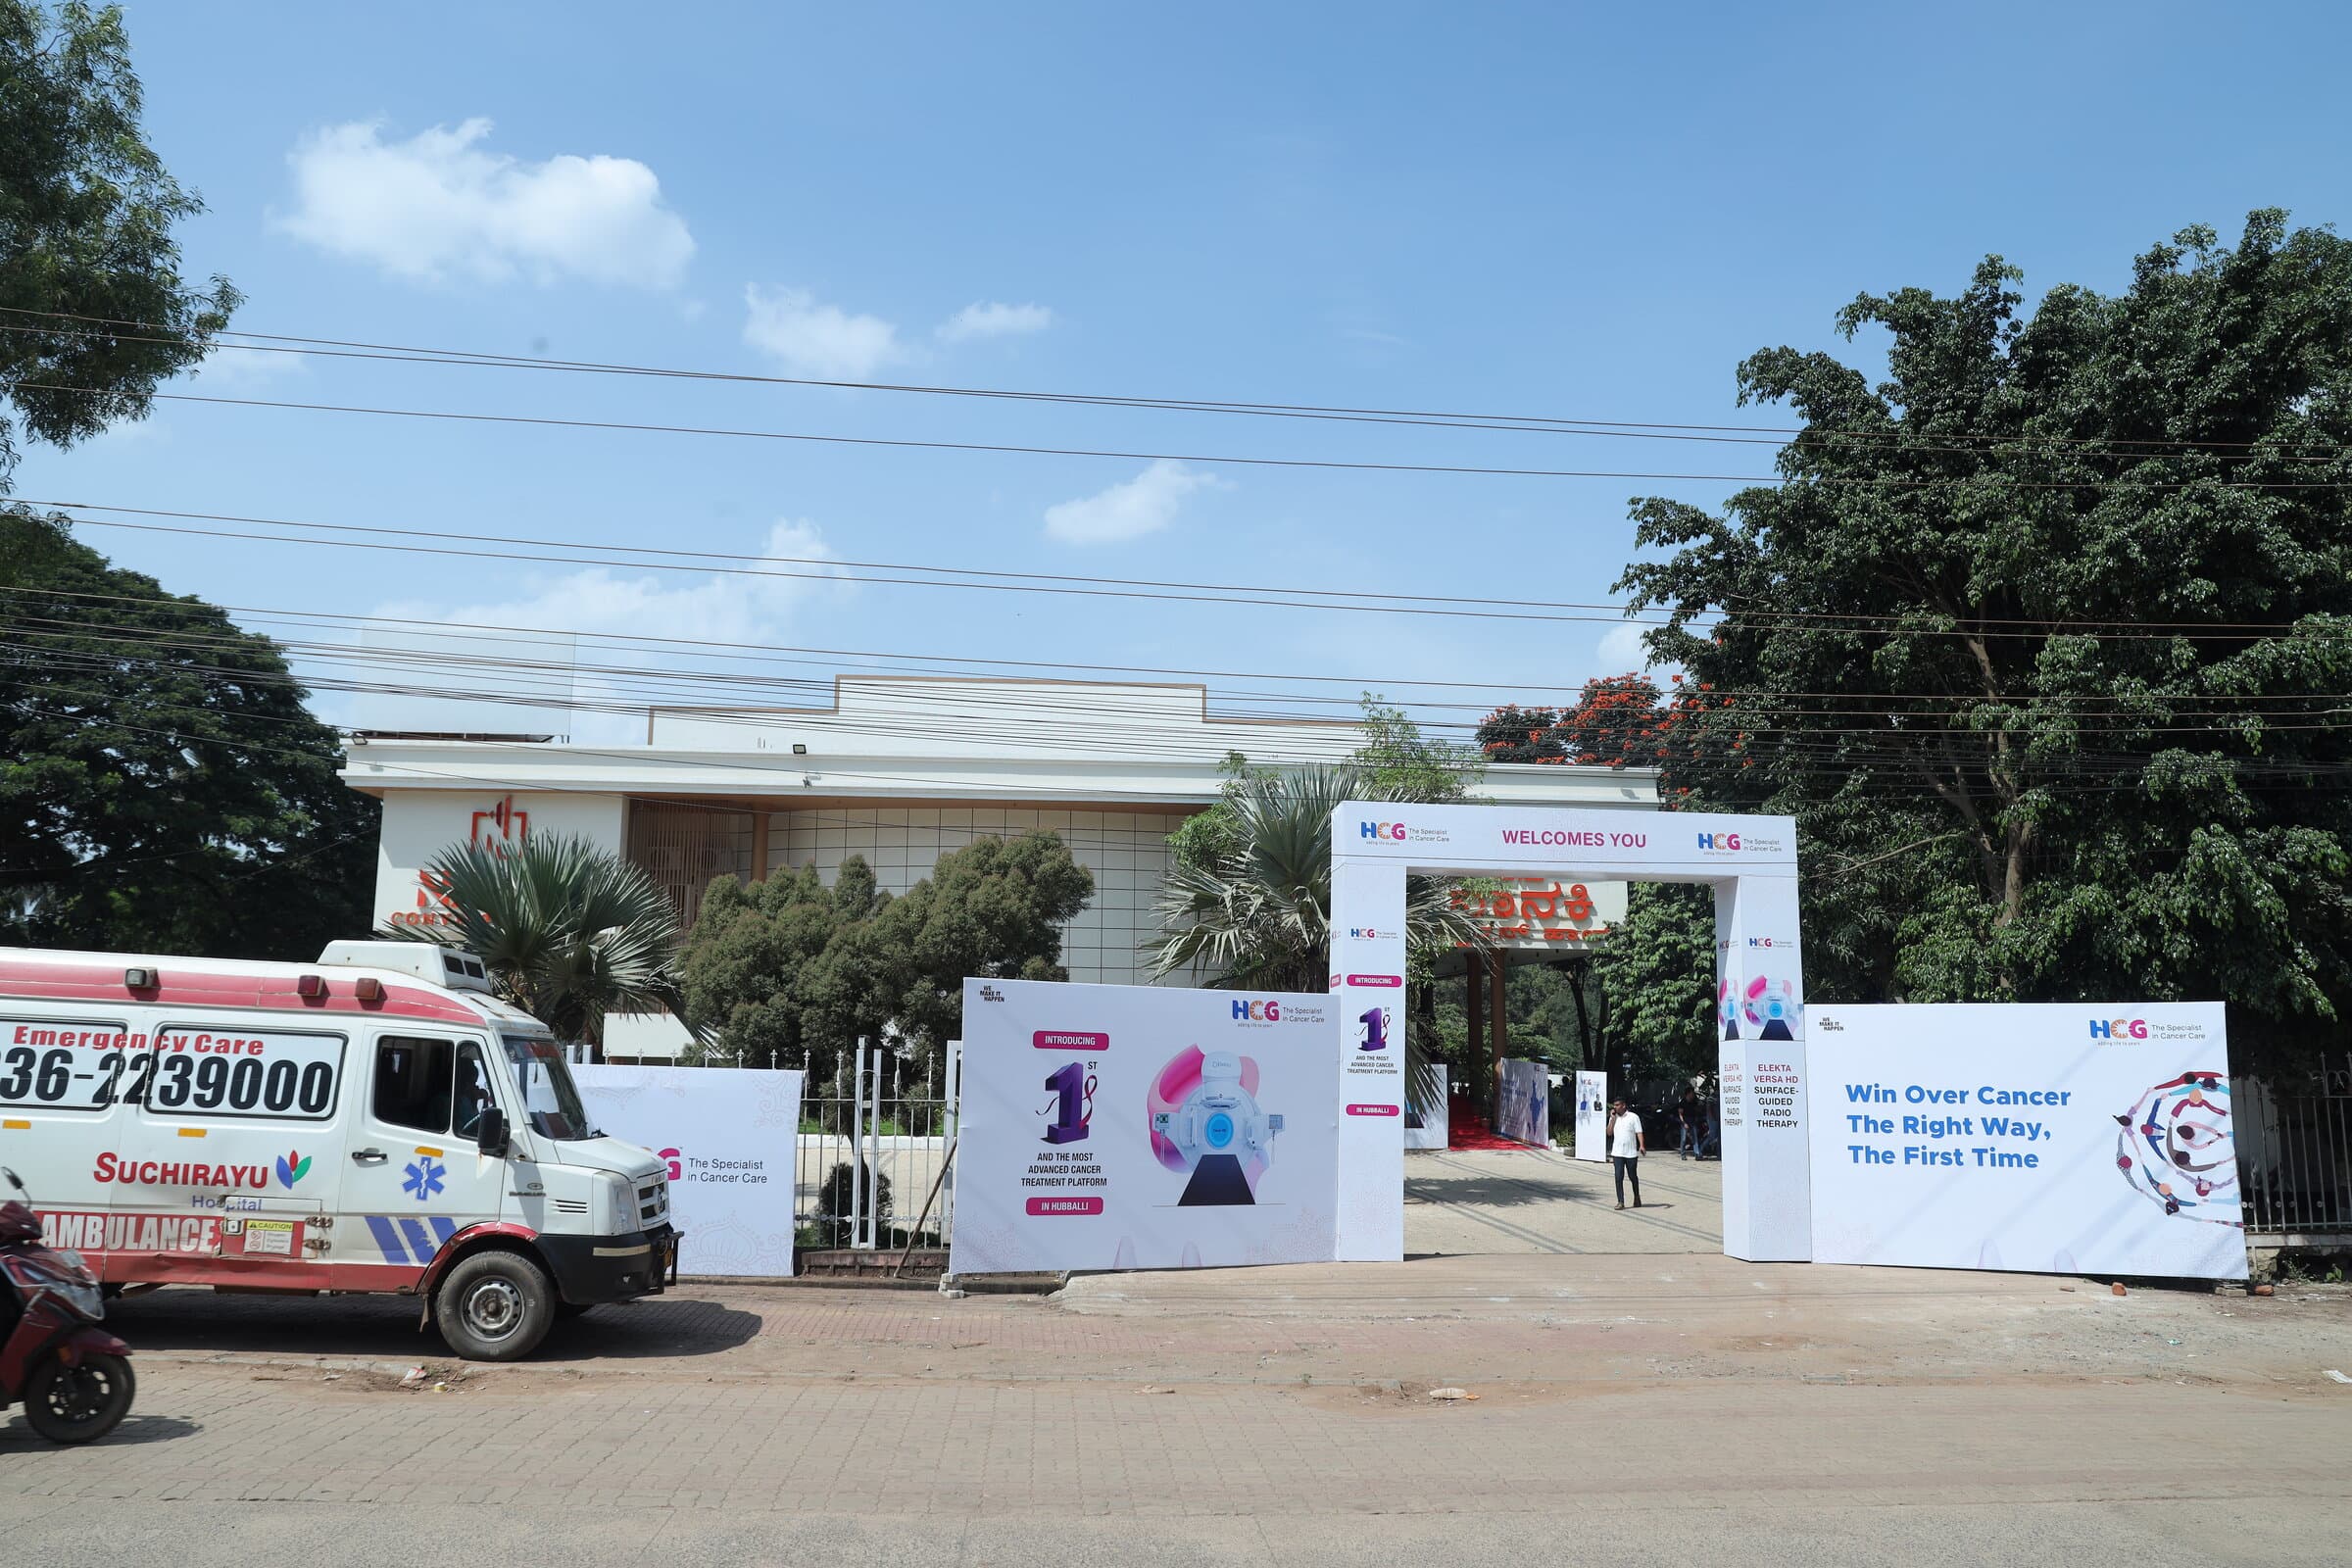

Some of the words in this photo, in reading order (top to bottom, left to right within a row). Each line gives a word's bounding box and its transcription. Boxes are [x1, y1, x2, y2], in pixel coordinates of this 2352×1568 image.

[1360, 821, 1406, 840] HCG
[1502, 830, 1604, 847] WELCOMES
[1609, 833, 1646, 848] YOU
[1697, 833, 1740, 850] HCG
[1350, 928, 1375, 938] HCG
[1749, 937, 1772, 948] HCG
[1232, 1000, 1280, 1021] HCG
[1295, 1006, 1322, 1015] Specialist
[2089, 1018, 2147, 1039] HCG
[2167, 1024, 2202, 1033] Specialist
[14, 1026, 188, 1054] Emergency
[194, 1034, 264, 1055] Care
[1045, 1035, 1096, 1046] INTRODUCING
[0, 1047, 333, 1113] 36-2239000
[1754, 1086, 1799, 1095] SURFACE-
[1845, 1083, 1896, 1103] Win
[1905, 1085, 1969, 1104] Over
[1978, 1086, 2071, 1106] Cancer
[1846, 1114, 1894, 1134] The
[1903, 1114, 1973, 1139] Right
[1982, 1117, 2051, 1141] Way,
[688, 1157, 708, 1168] The
[711, 1158, 763, 1172] Specialist
[1037, 1152, 1054, 1161] AND
[1055, 1152, 1069, 1161] THE
[1072, 1152, 1094, 1161] MOST
[1847, 1146, 1895, 1164] The
[1904, 1145, 1964, 1166] First
[1972, 1147, 2038, 1168] Time
[93, 1152, 268, 1189] SUCHIRAYU
[1028, 1165, 1069, 1174] ADVANCED
[1071, 1165, 1102, 1174] CANCER
[687, 1172, 697, 1182] in
[700, 1173, 738, 1183] Cancer
[742, 1173, 767, 1184] Care
[1021, 1177, 1065, 1187] TREATMENT
[1067, 1177, 1107, 1187] PLATFORM
[1041, 1201, 1049, 1211] IN
[1051, 1201, 1089, 1211] HUBBALLI
[41, 1214, 215, 1252] AMBULANCE
